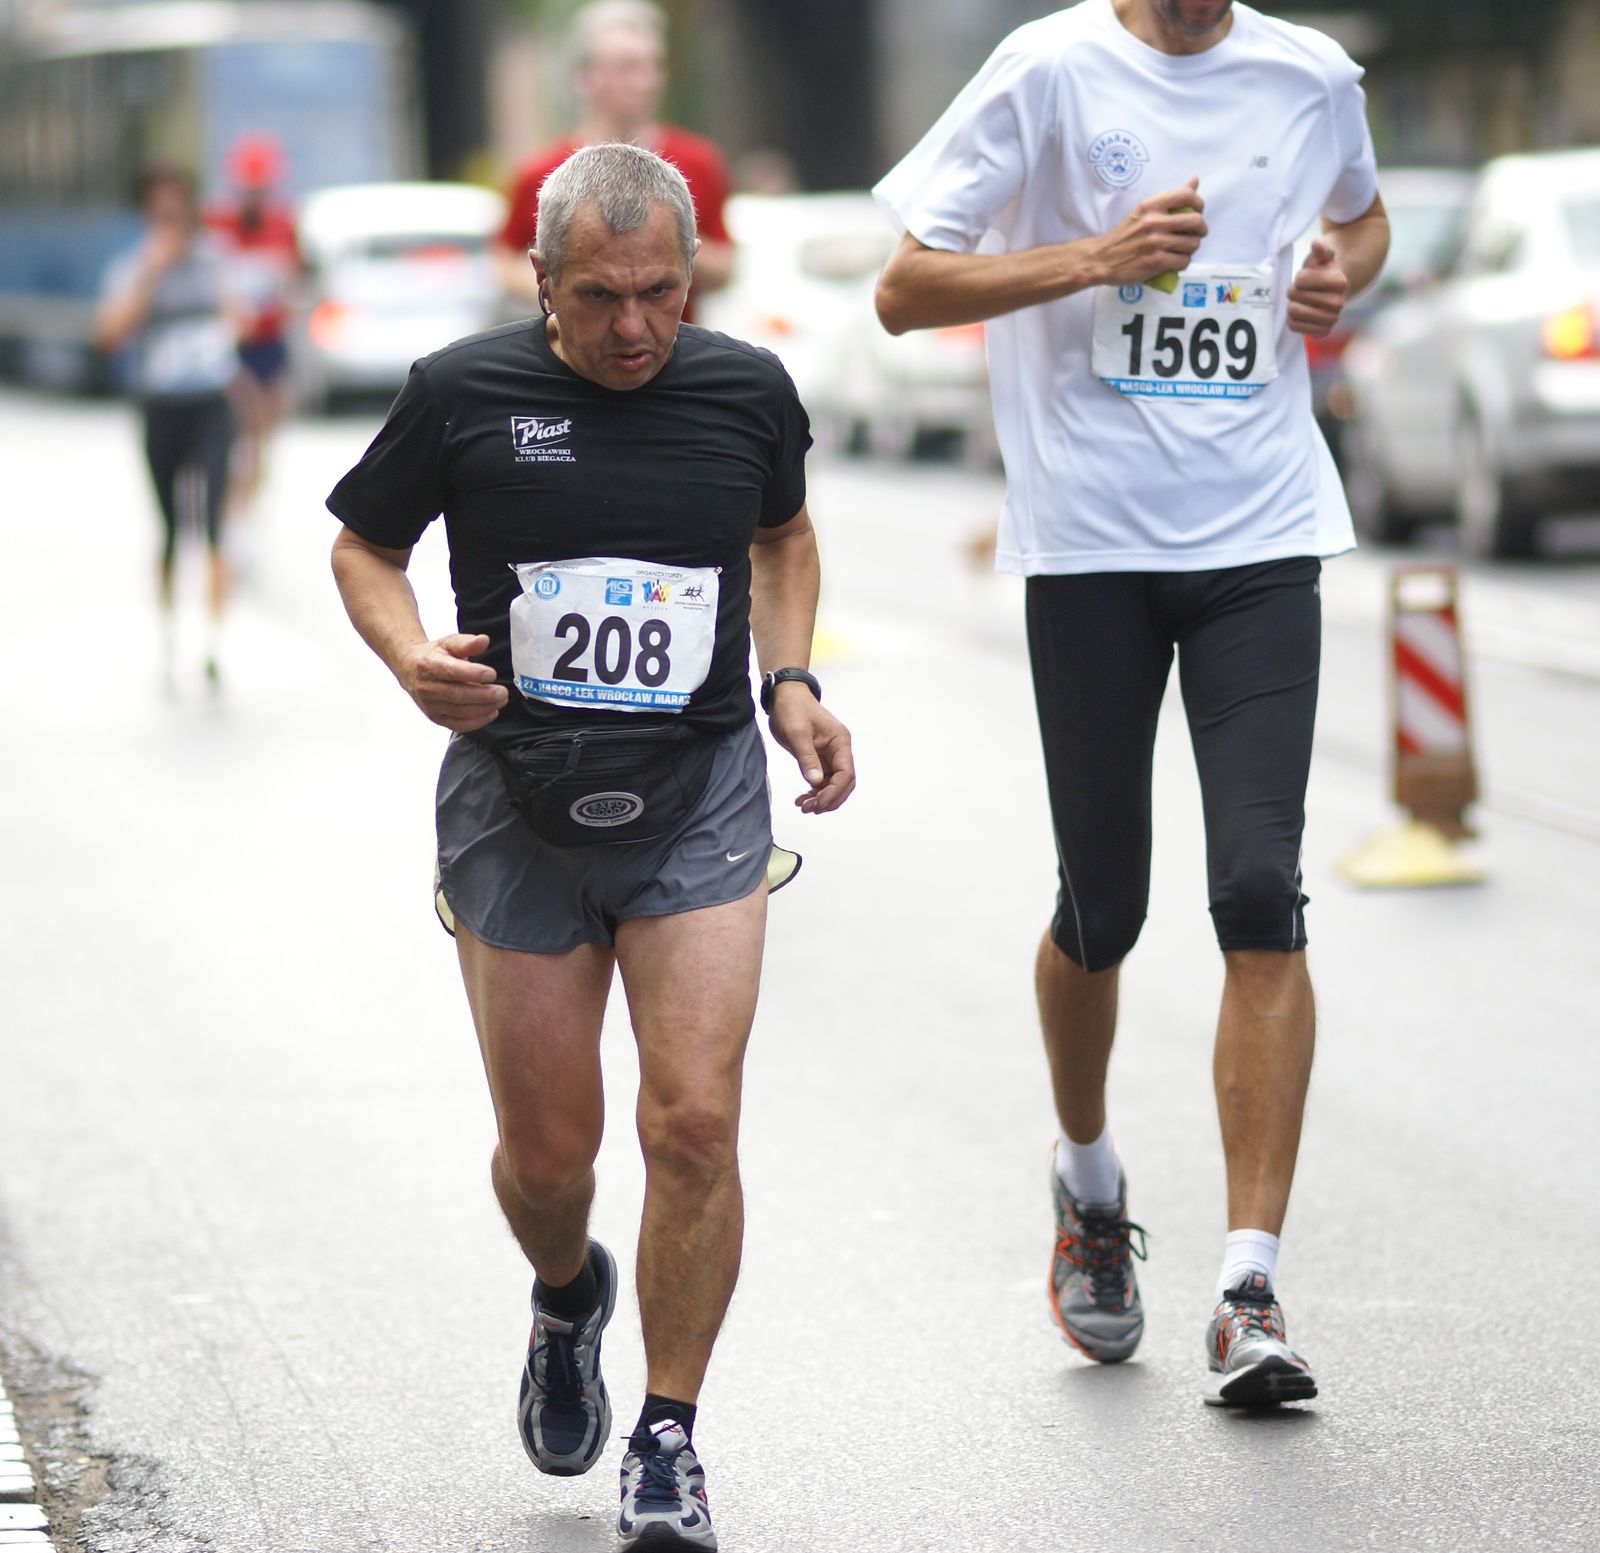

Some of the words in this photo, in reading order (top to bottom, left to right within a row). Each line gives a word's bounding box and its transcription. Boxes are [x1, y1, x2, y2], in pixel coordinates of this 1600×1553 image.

[1121, 313, 1257, 380] 1569
[516, 419, 572, 445] Piast
[553, 612, 671, 688] 208
[538, 683, 594, 699] HASCO-LEK
[597, 689, 652, 704] WROCŁAW
[590, 800, 624, 809] EXPO
[591, 807, 621, 817] 2000
